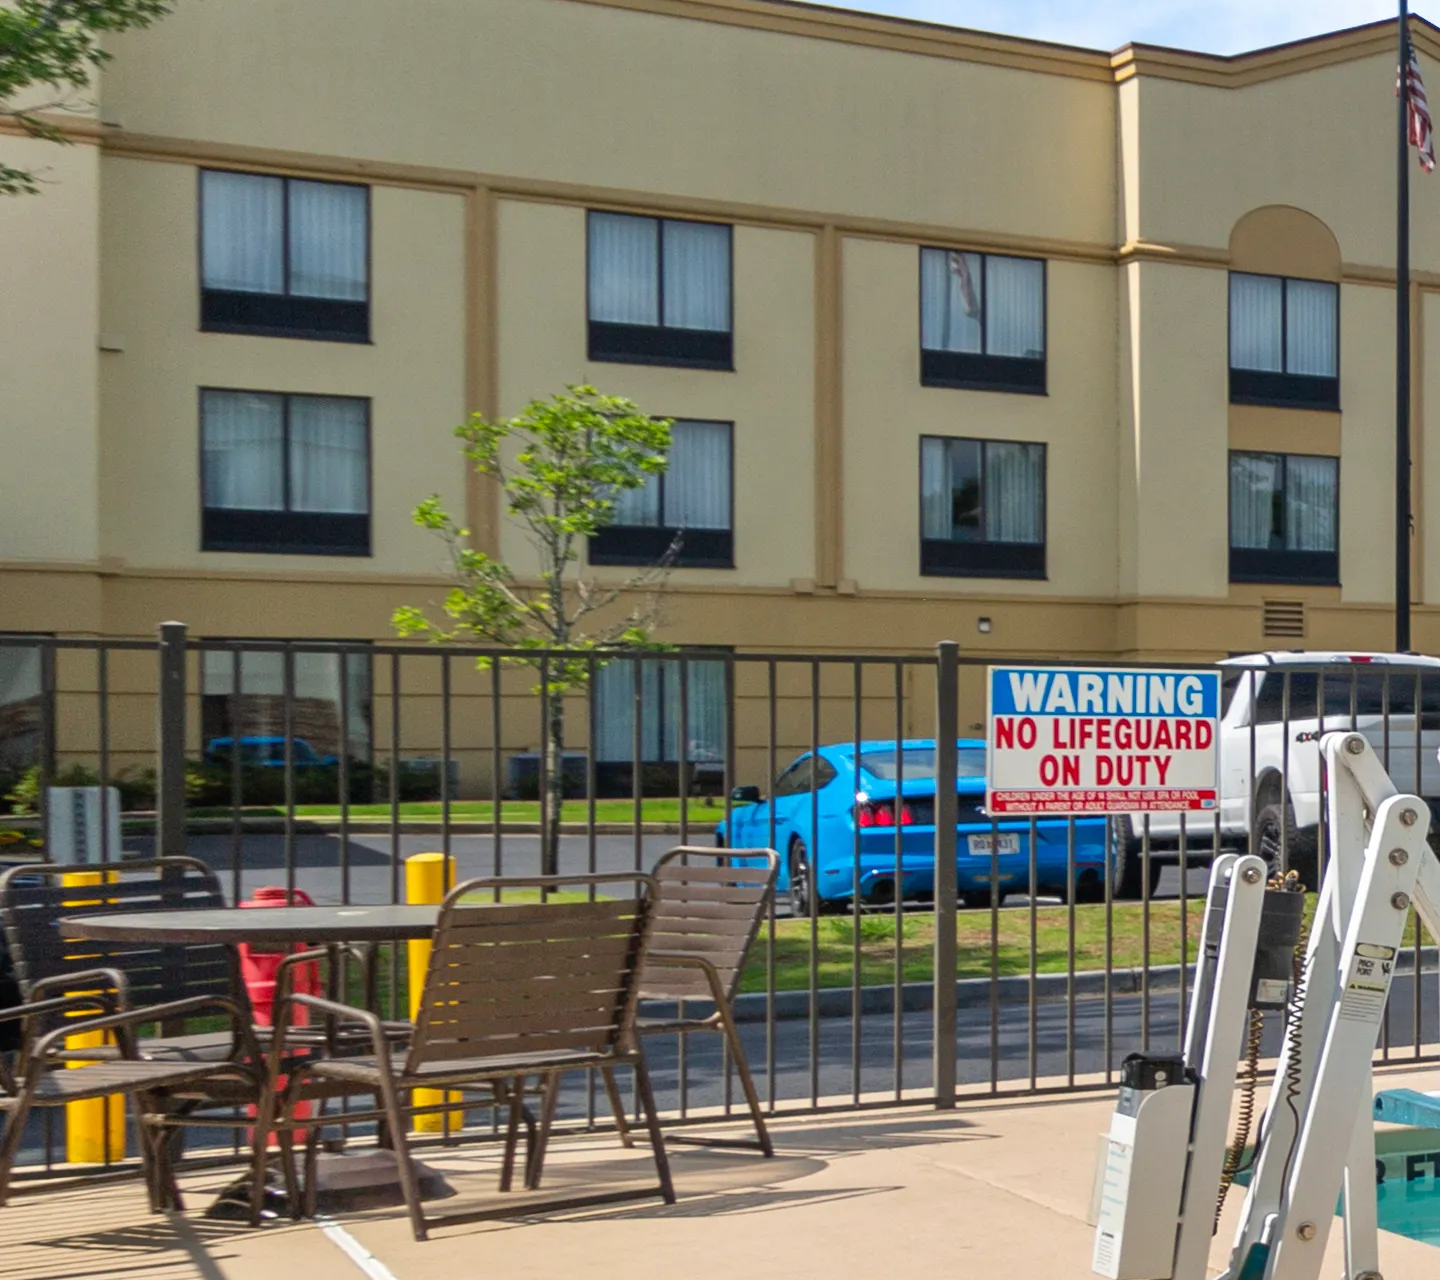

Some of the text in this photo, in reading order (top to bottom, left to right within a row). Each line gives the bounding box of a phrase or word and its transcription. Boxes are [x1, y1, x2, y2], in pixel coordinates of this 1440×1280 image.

[1009, 672, 1204, 715] WARNING
[995, 717, 1212, 750] NO LIFEGUARD
[1039, 754, 1172, 787] ON DUTY
